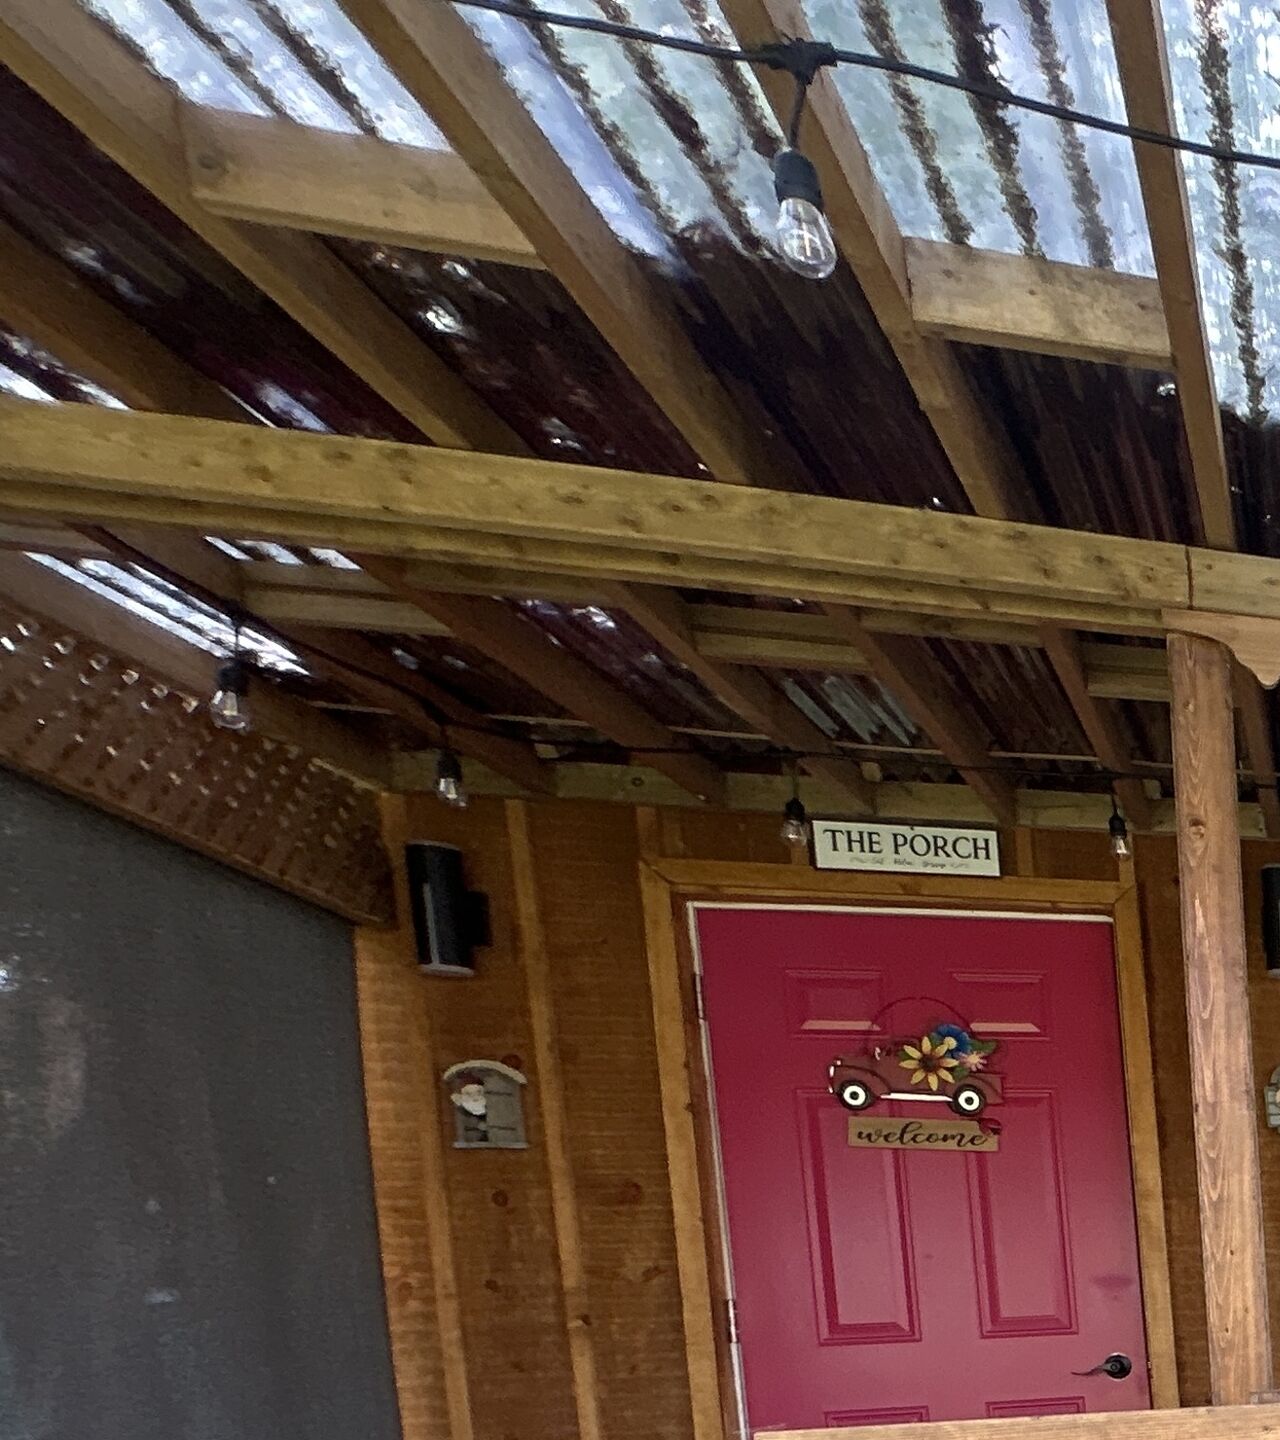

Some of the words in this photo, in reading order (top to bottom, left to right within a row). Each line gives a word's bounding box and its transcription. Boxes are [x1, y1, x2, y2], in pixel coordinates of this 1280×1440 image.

[823, 829, 883, 854] THE
[892, 833, 991, 860] PORCH
[857, 1121, 988, 1147] welcome
